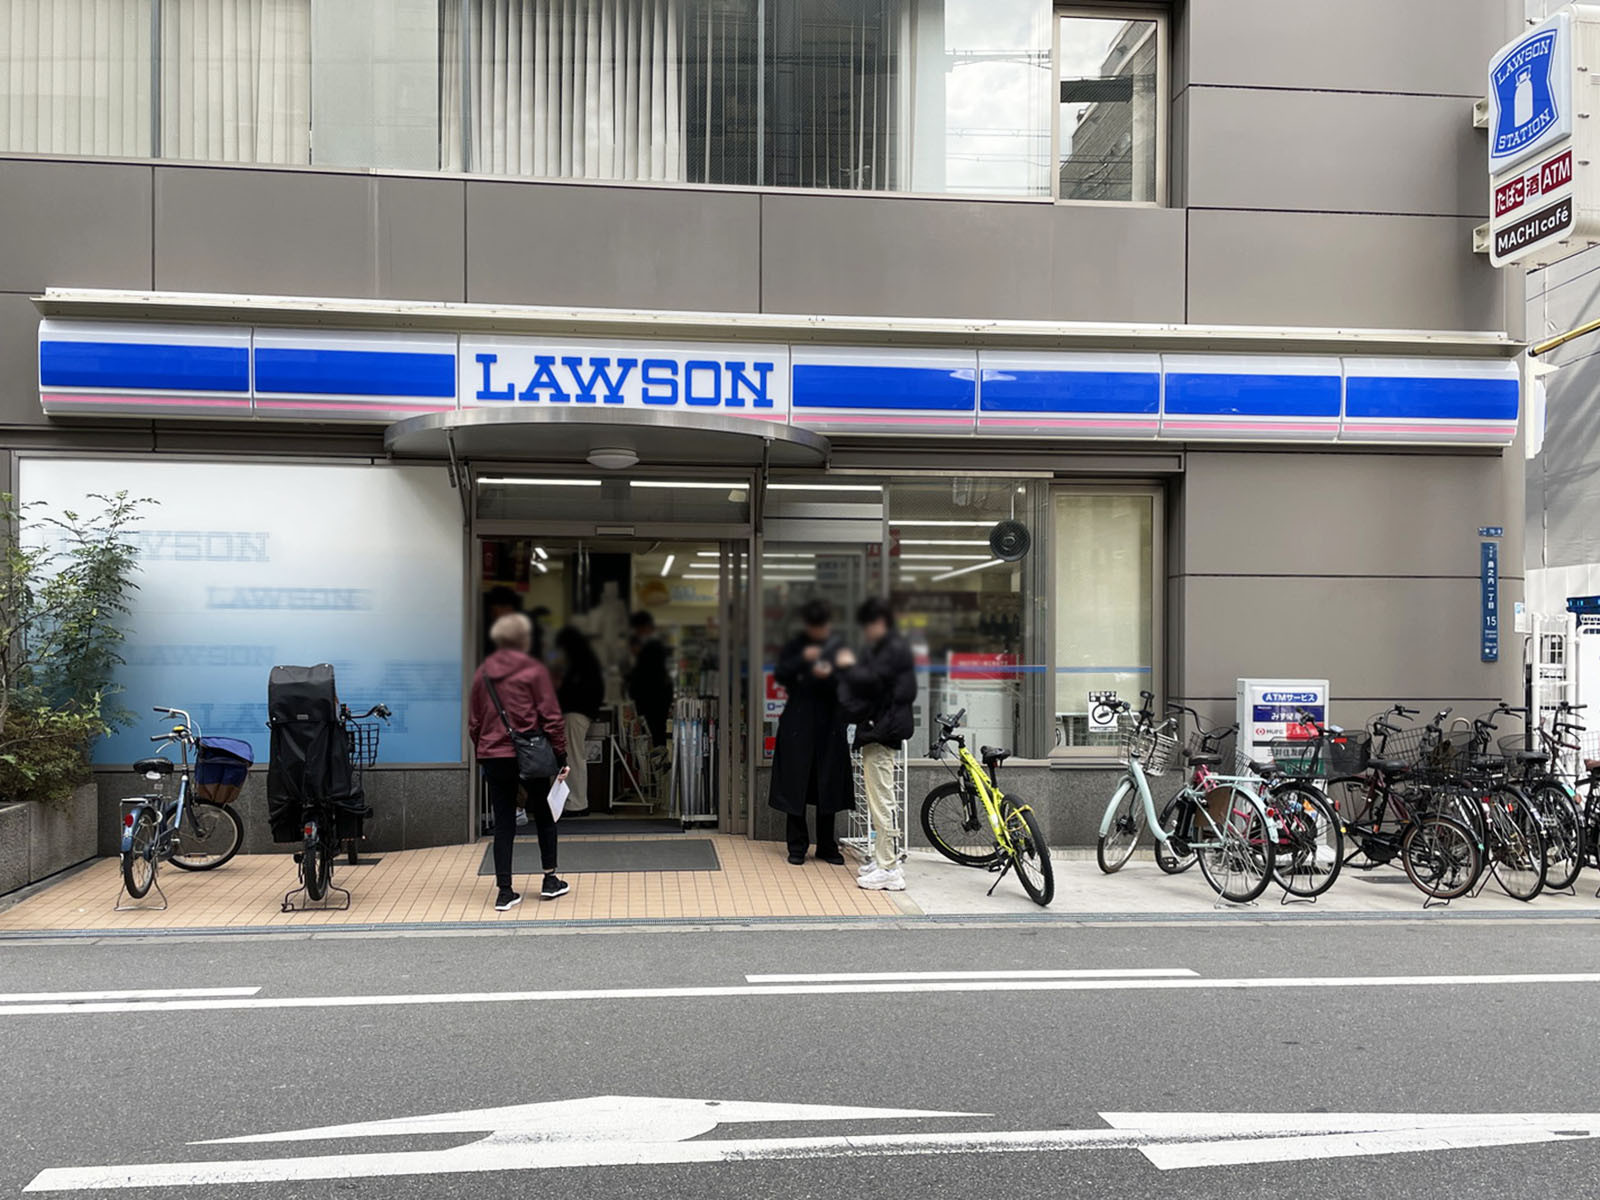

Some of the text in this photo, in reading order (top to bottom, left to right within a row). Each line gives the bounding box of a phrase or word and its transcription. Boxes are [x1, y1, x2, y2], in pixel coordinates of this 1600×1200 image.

[1496, 39, 1550, 85] LAWSON
[1498, 107, 1551, 149] STATION
[1497, 182, 1523, 213] たばこ
[1542, 156, 1570, 190] ATM
[1498, 205, 1568, 253] MACHI café
[475, 353, 774, 408] LAWSON
[1486, 616, 1497, 626] 15
[1265, 693, 1315, 702] ATMサービス
